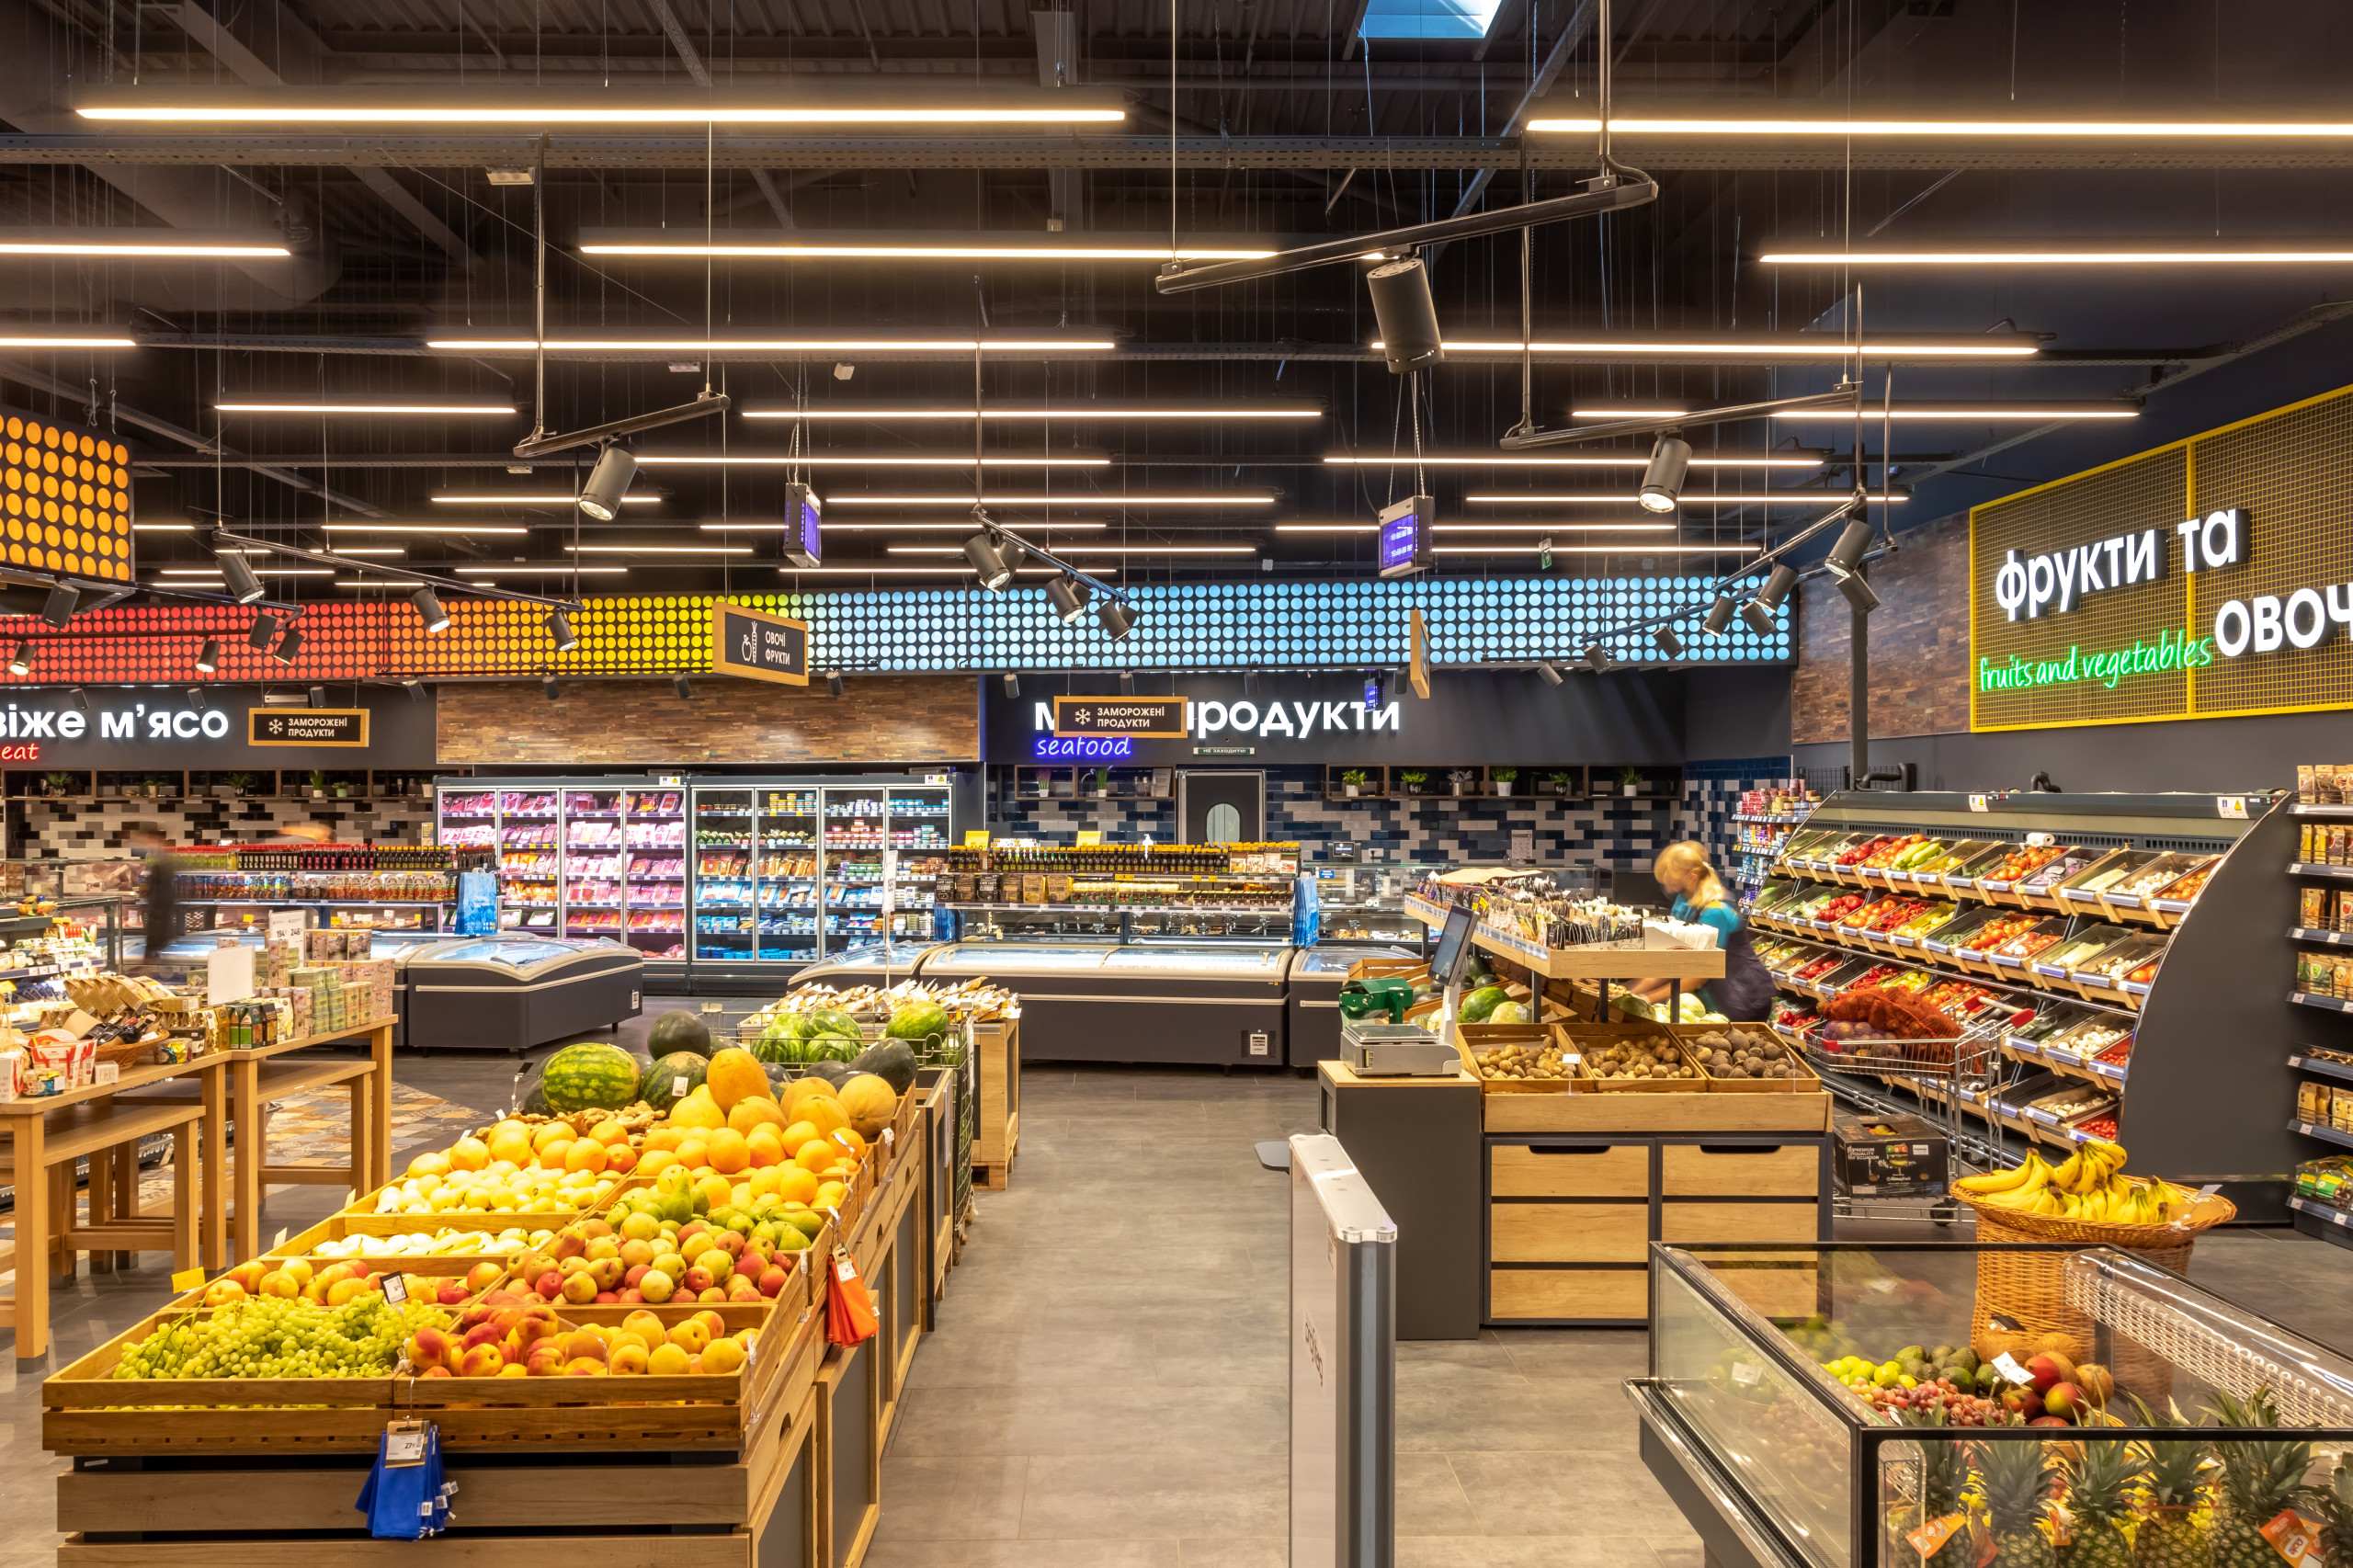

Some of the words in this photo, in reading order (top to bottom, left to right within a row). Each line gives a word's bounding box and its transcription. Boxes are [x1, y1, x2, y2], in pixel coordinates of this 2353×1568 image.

[1995, 529, 2155, 620] фрукти
[2177, 509, 2237, 572] та
[766, 648, 790, 665] ФРУКТИ
[1980, 654, 2033, 690] fruits
[2037, 645, 2079, 684] and
[2083, 629, 2212, 687] vegetables
[1097, 718, 1151, 728] ПРОДУКТИ
[288, 728, 335, 737] ПРОДУКТИ
[1036, 736, 1131, 756] seafood
